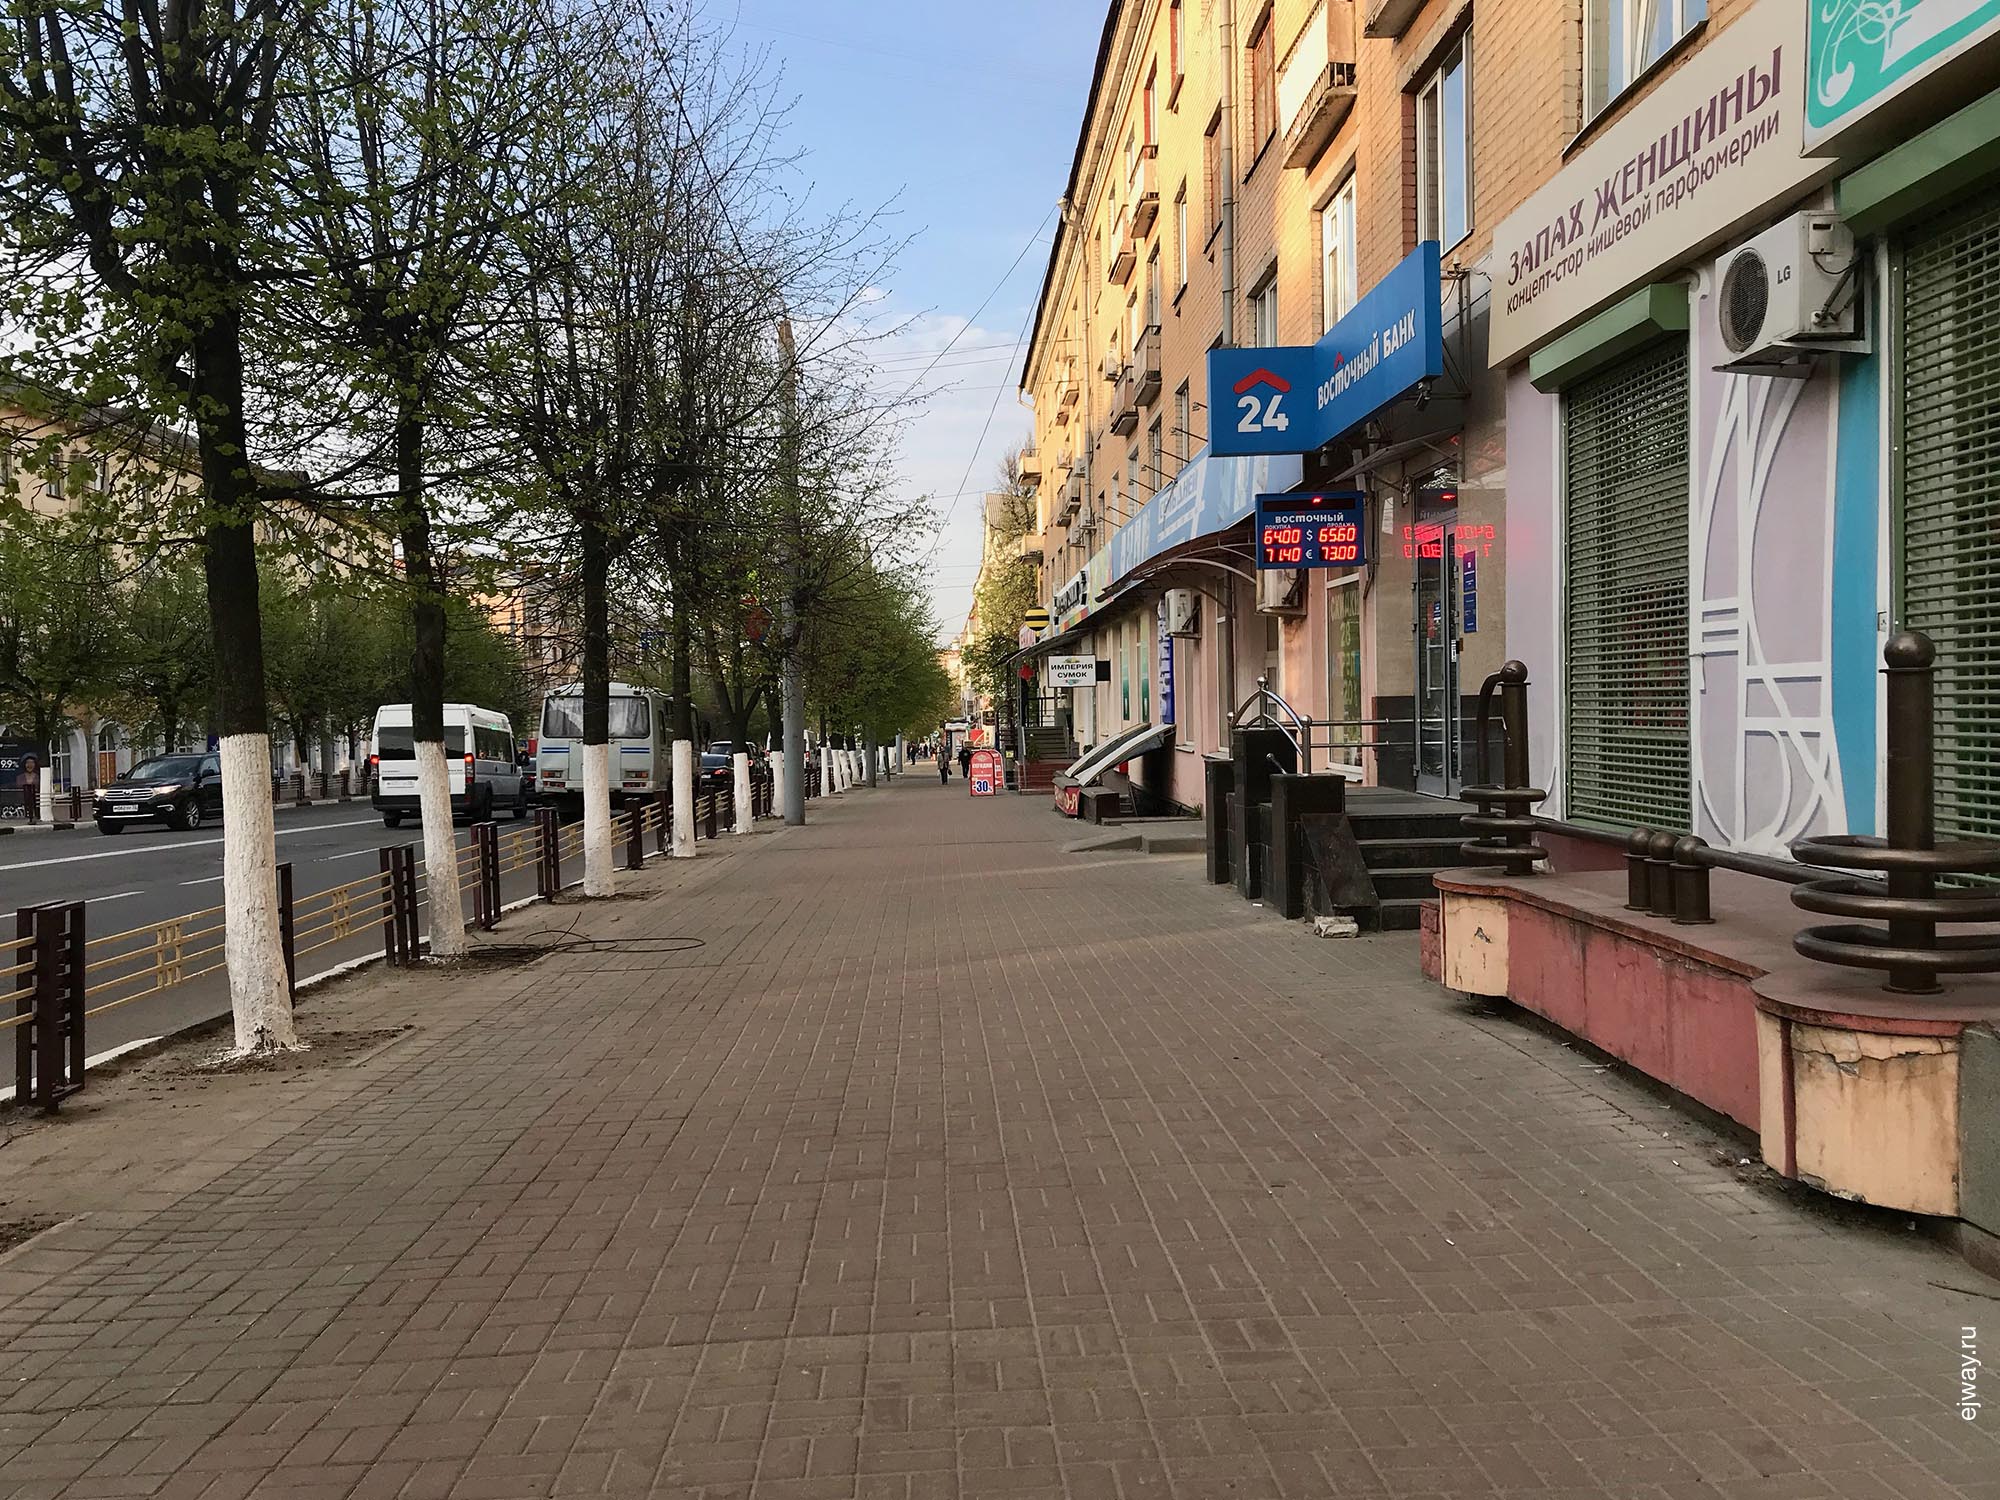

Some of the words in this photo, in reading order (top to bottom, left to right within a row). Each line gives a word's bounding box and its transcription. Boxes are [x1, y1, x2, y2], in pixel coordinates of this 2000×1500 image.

[1507, 198, 1585, 287] ЗАПАХ
[1590, 45, 1783, 237] ЖЕНЩИНЫ
[1506, 247, 1584, 316] концепт-стор
[1587, 192, 1651, 262] нишевой
[1656, 110, 1780, 215] парфюмерии
[1777, 265, 1791, 285] LG
[1382, 308, 1416, 359] БАНК
[1237, 394, 1289, 433] 24
[1306, 529, 1313, 541] $
[1305, 549, 1313, 559] €
[1050, 663, 1094, 671] ИМПЕРИЯ
[1057, 671, 1087, 679] СУМОК
